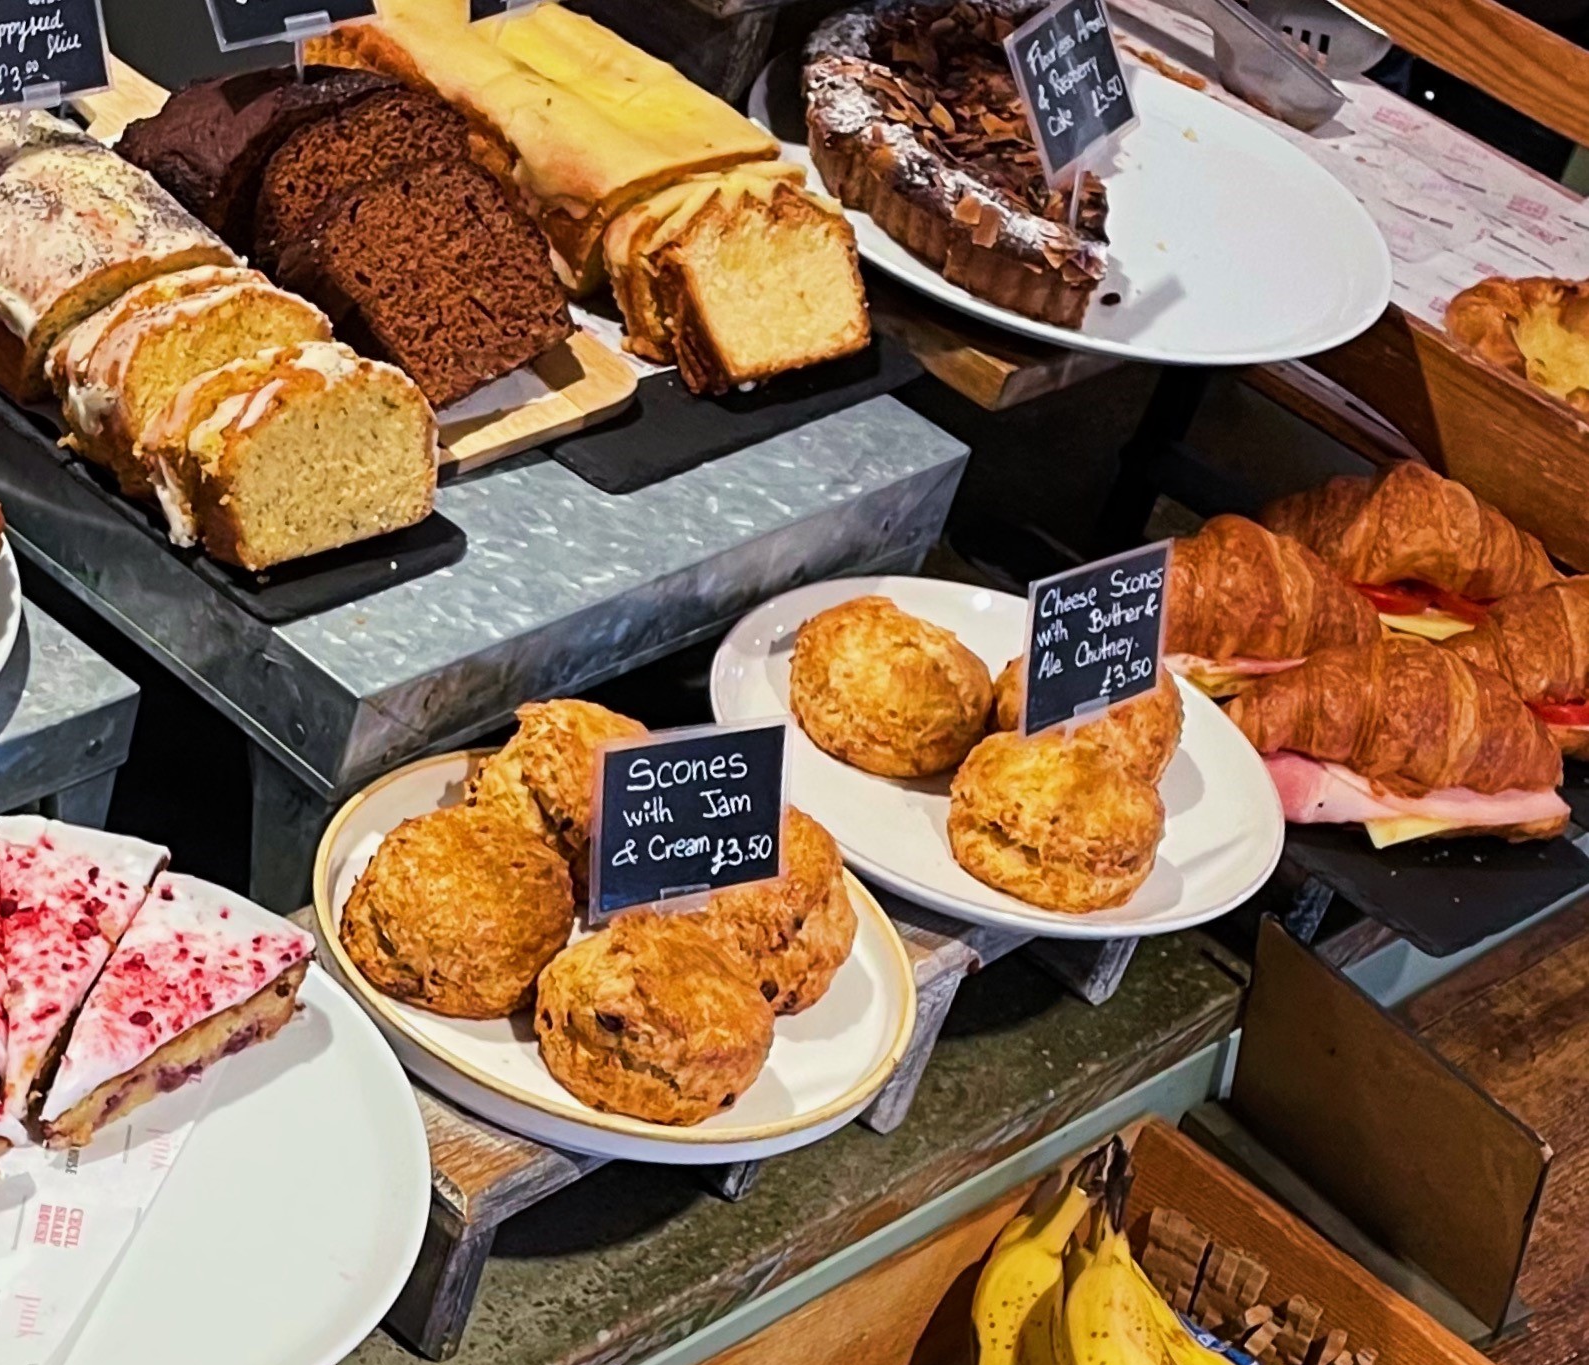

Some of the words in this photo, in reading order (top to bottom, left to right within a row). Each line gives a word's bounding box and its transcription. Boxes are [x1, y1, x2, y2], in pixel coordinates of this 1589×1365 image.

[1040, 587, 1098, 618] Cheese
[1109, 568, 1164, 599] Scones
[1036, 618, 1069, 648] with
[1087, 602, 1144, 633] Butter
[1037, 650, 1064, 681] Ale
[1099, 656, 1152, 697] £3.50
[626, 752, 748, 792] Scones
[622, 796, 674, 828] with
[699, 788, 752, 819] Jam
[611, 838, 639, 867] &
[648, 834, 711, 861] Cream
[710, 834, 773, 876] £3.50
[32, 1203, 52, 1244] HOUSE
[48, 1205, 67, 1247] SHARP
[63, 1207, 84, 1250] CECIL
